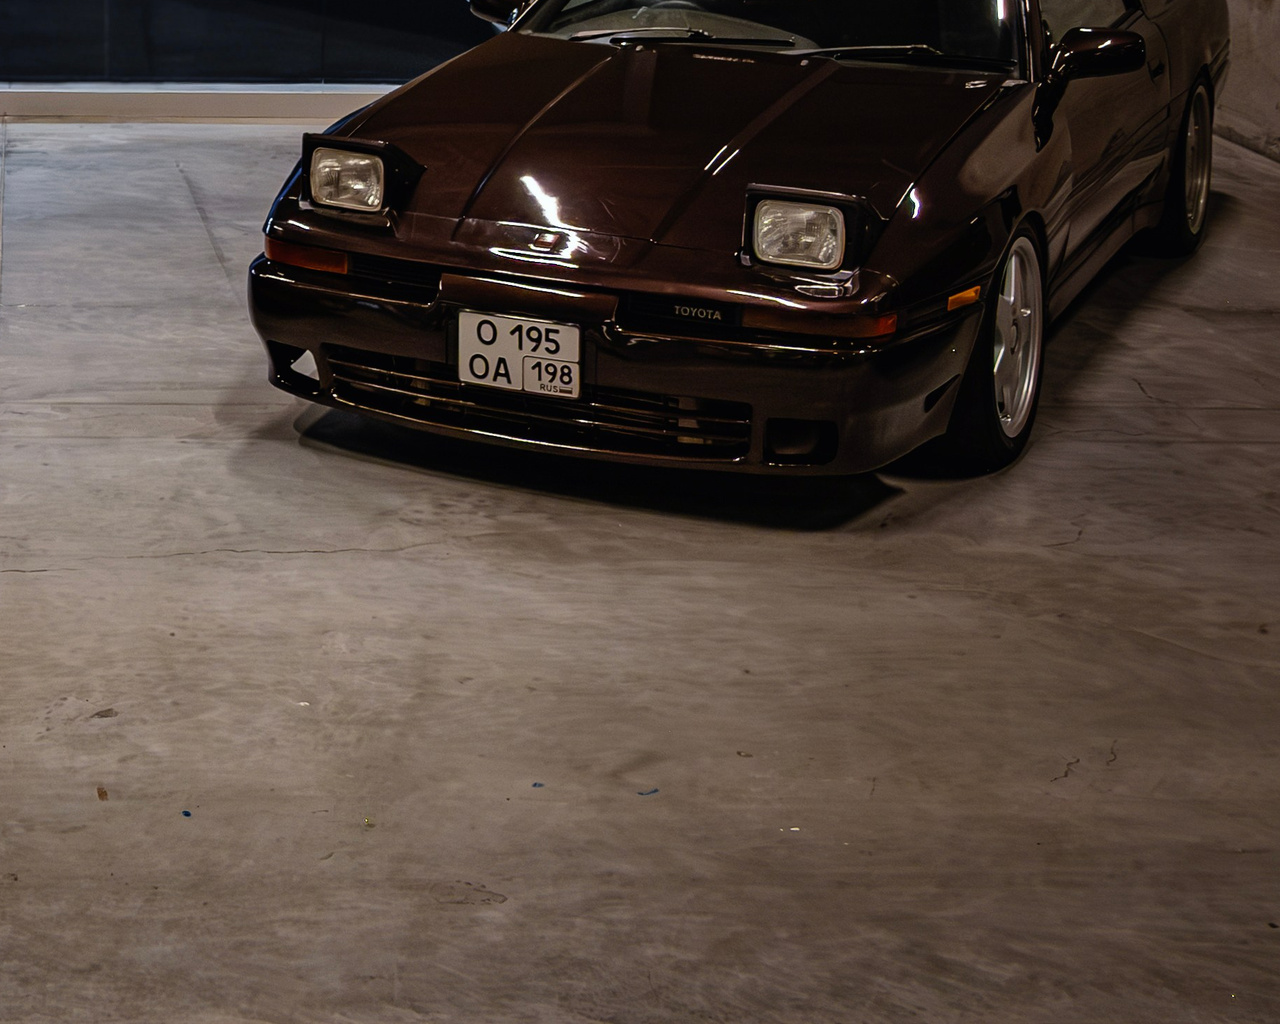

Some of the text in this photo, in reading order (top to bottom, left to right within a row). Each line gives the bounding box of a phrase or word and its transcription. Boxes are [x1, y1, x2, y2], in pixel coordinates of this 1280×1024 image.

[674, 305, 722, 320] TOYOTA
[509, 324, 561, 355] 195
[531, 361, 573, 385] 198
[539, 383, 559, 394] RUS
